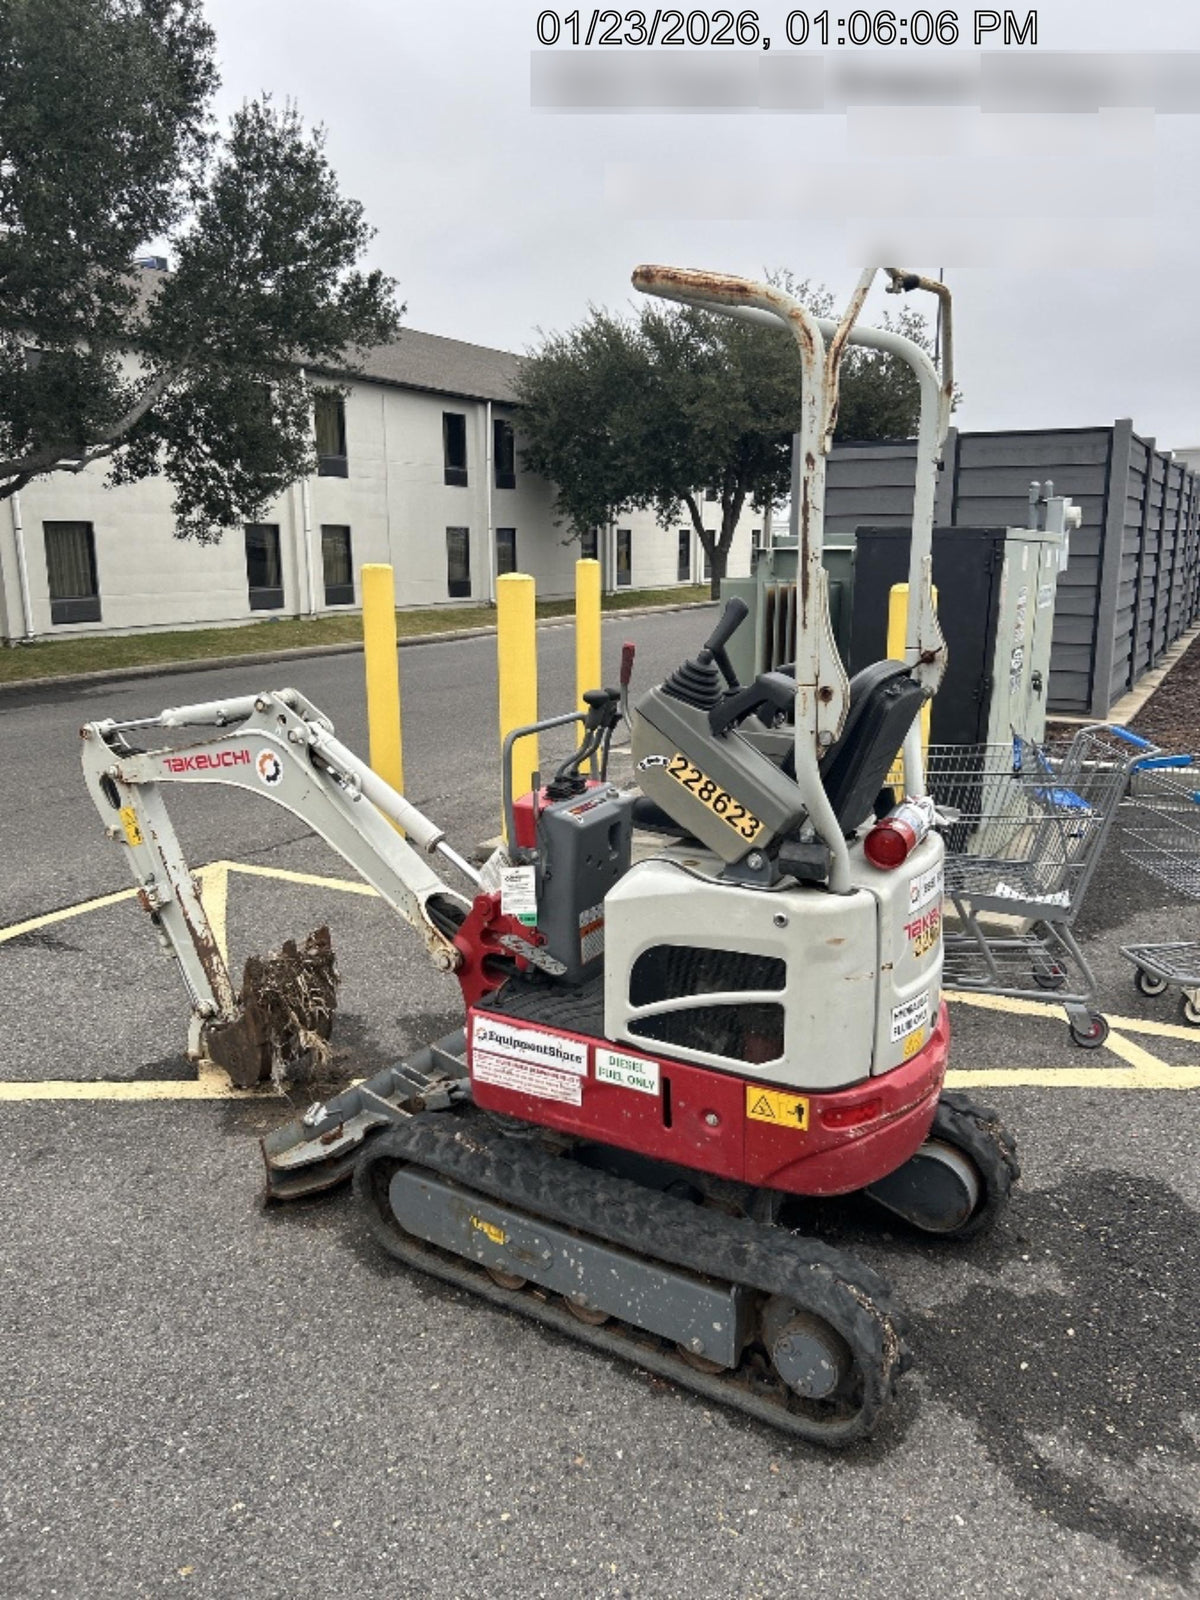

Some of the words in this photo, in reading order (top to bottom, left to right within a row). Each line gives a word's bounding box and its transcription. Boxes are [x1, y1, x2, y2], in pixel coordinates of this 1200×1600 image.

[668, 757, 760, 838] 228623
[488, 1030, 582, 1064] EquipmentShare
[599, 1066, 622, 1083] FUEL
[626, 1074, 655, 1091] ONLY
[608, 1055, 645, 1074] DIESEL
